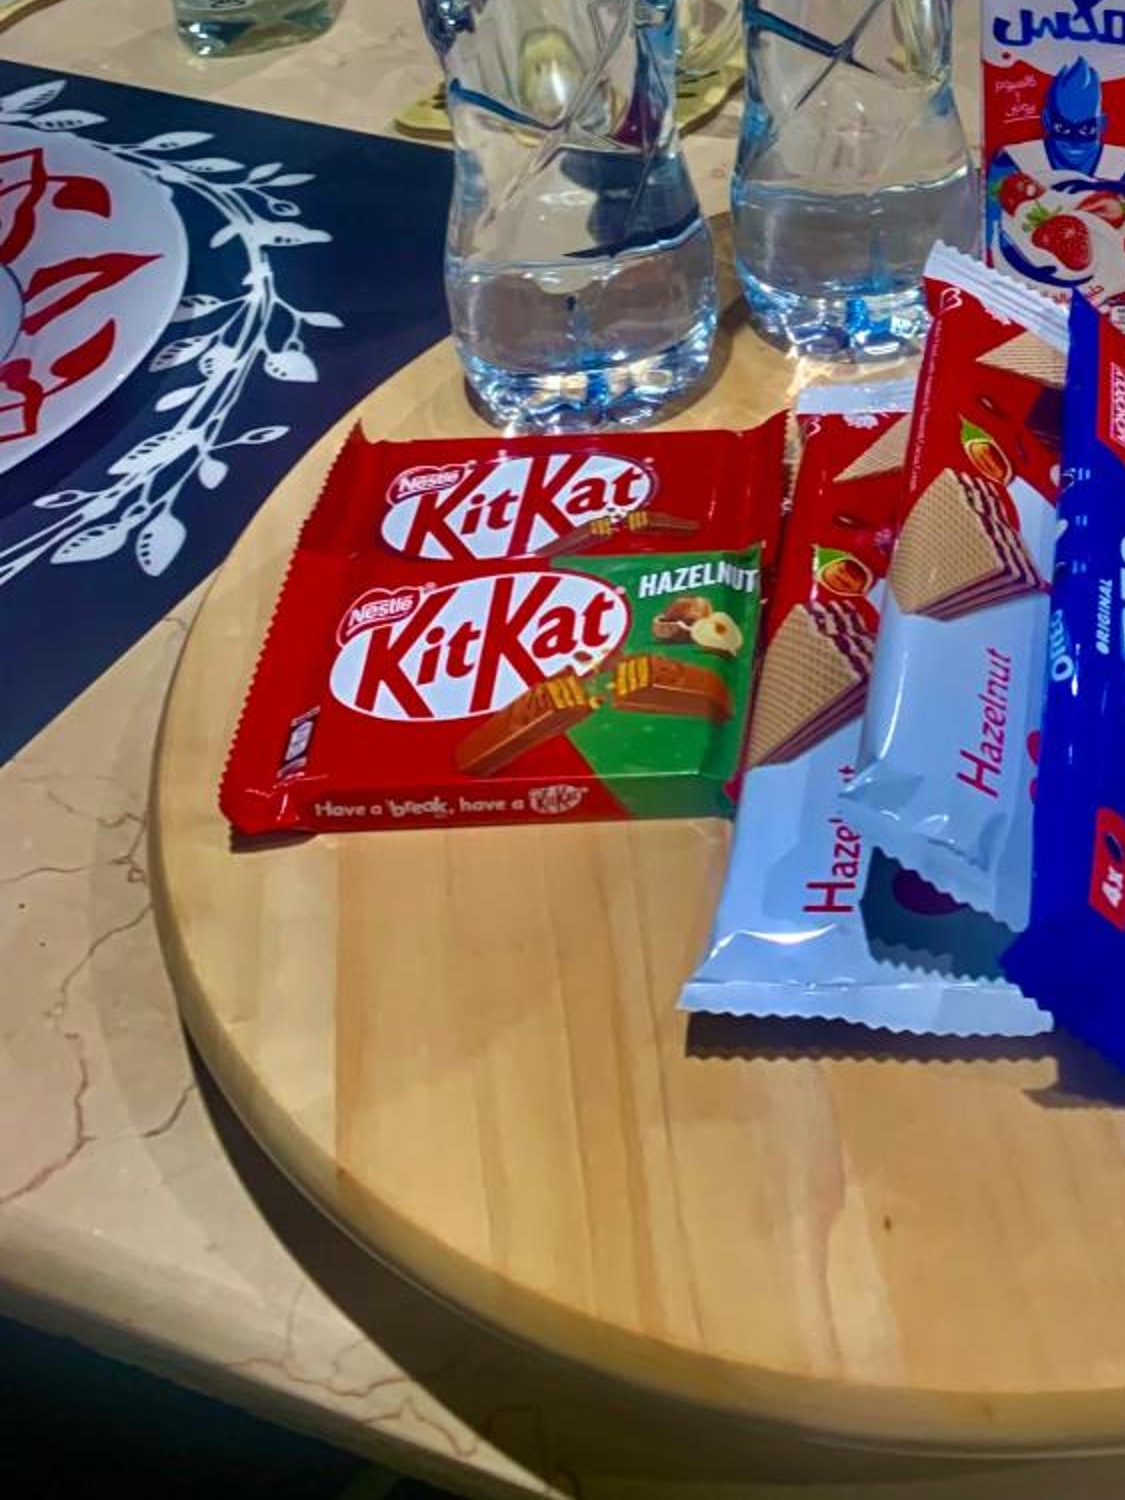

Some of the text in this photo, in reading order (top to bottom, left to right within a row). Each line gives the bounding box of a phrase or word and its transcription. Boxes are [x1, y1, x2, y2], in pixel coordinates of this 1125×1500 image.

[404, 453, 642, 560] KitKat
[638, 561, 759, 598] HAZELNUT
[1096, 579, 1113, 655] ORIGINAL
[354, 575, 615, 718] KitKat
[957, 648, 1012, 798] Hazelnut
[314, 800, 366, 817] Have
[370, 804, 383, 816] a
[459, 796, 506, 812] have
[511, 799, 525, 810] a
